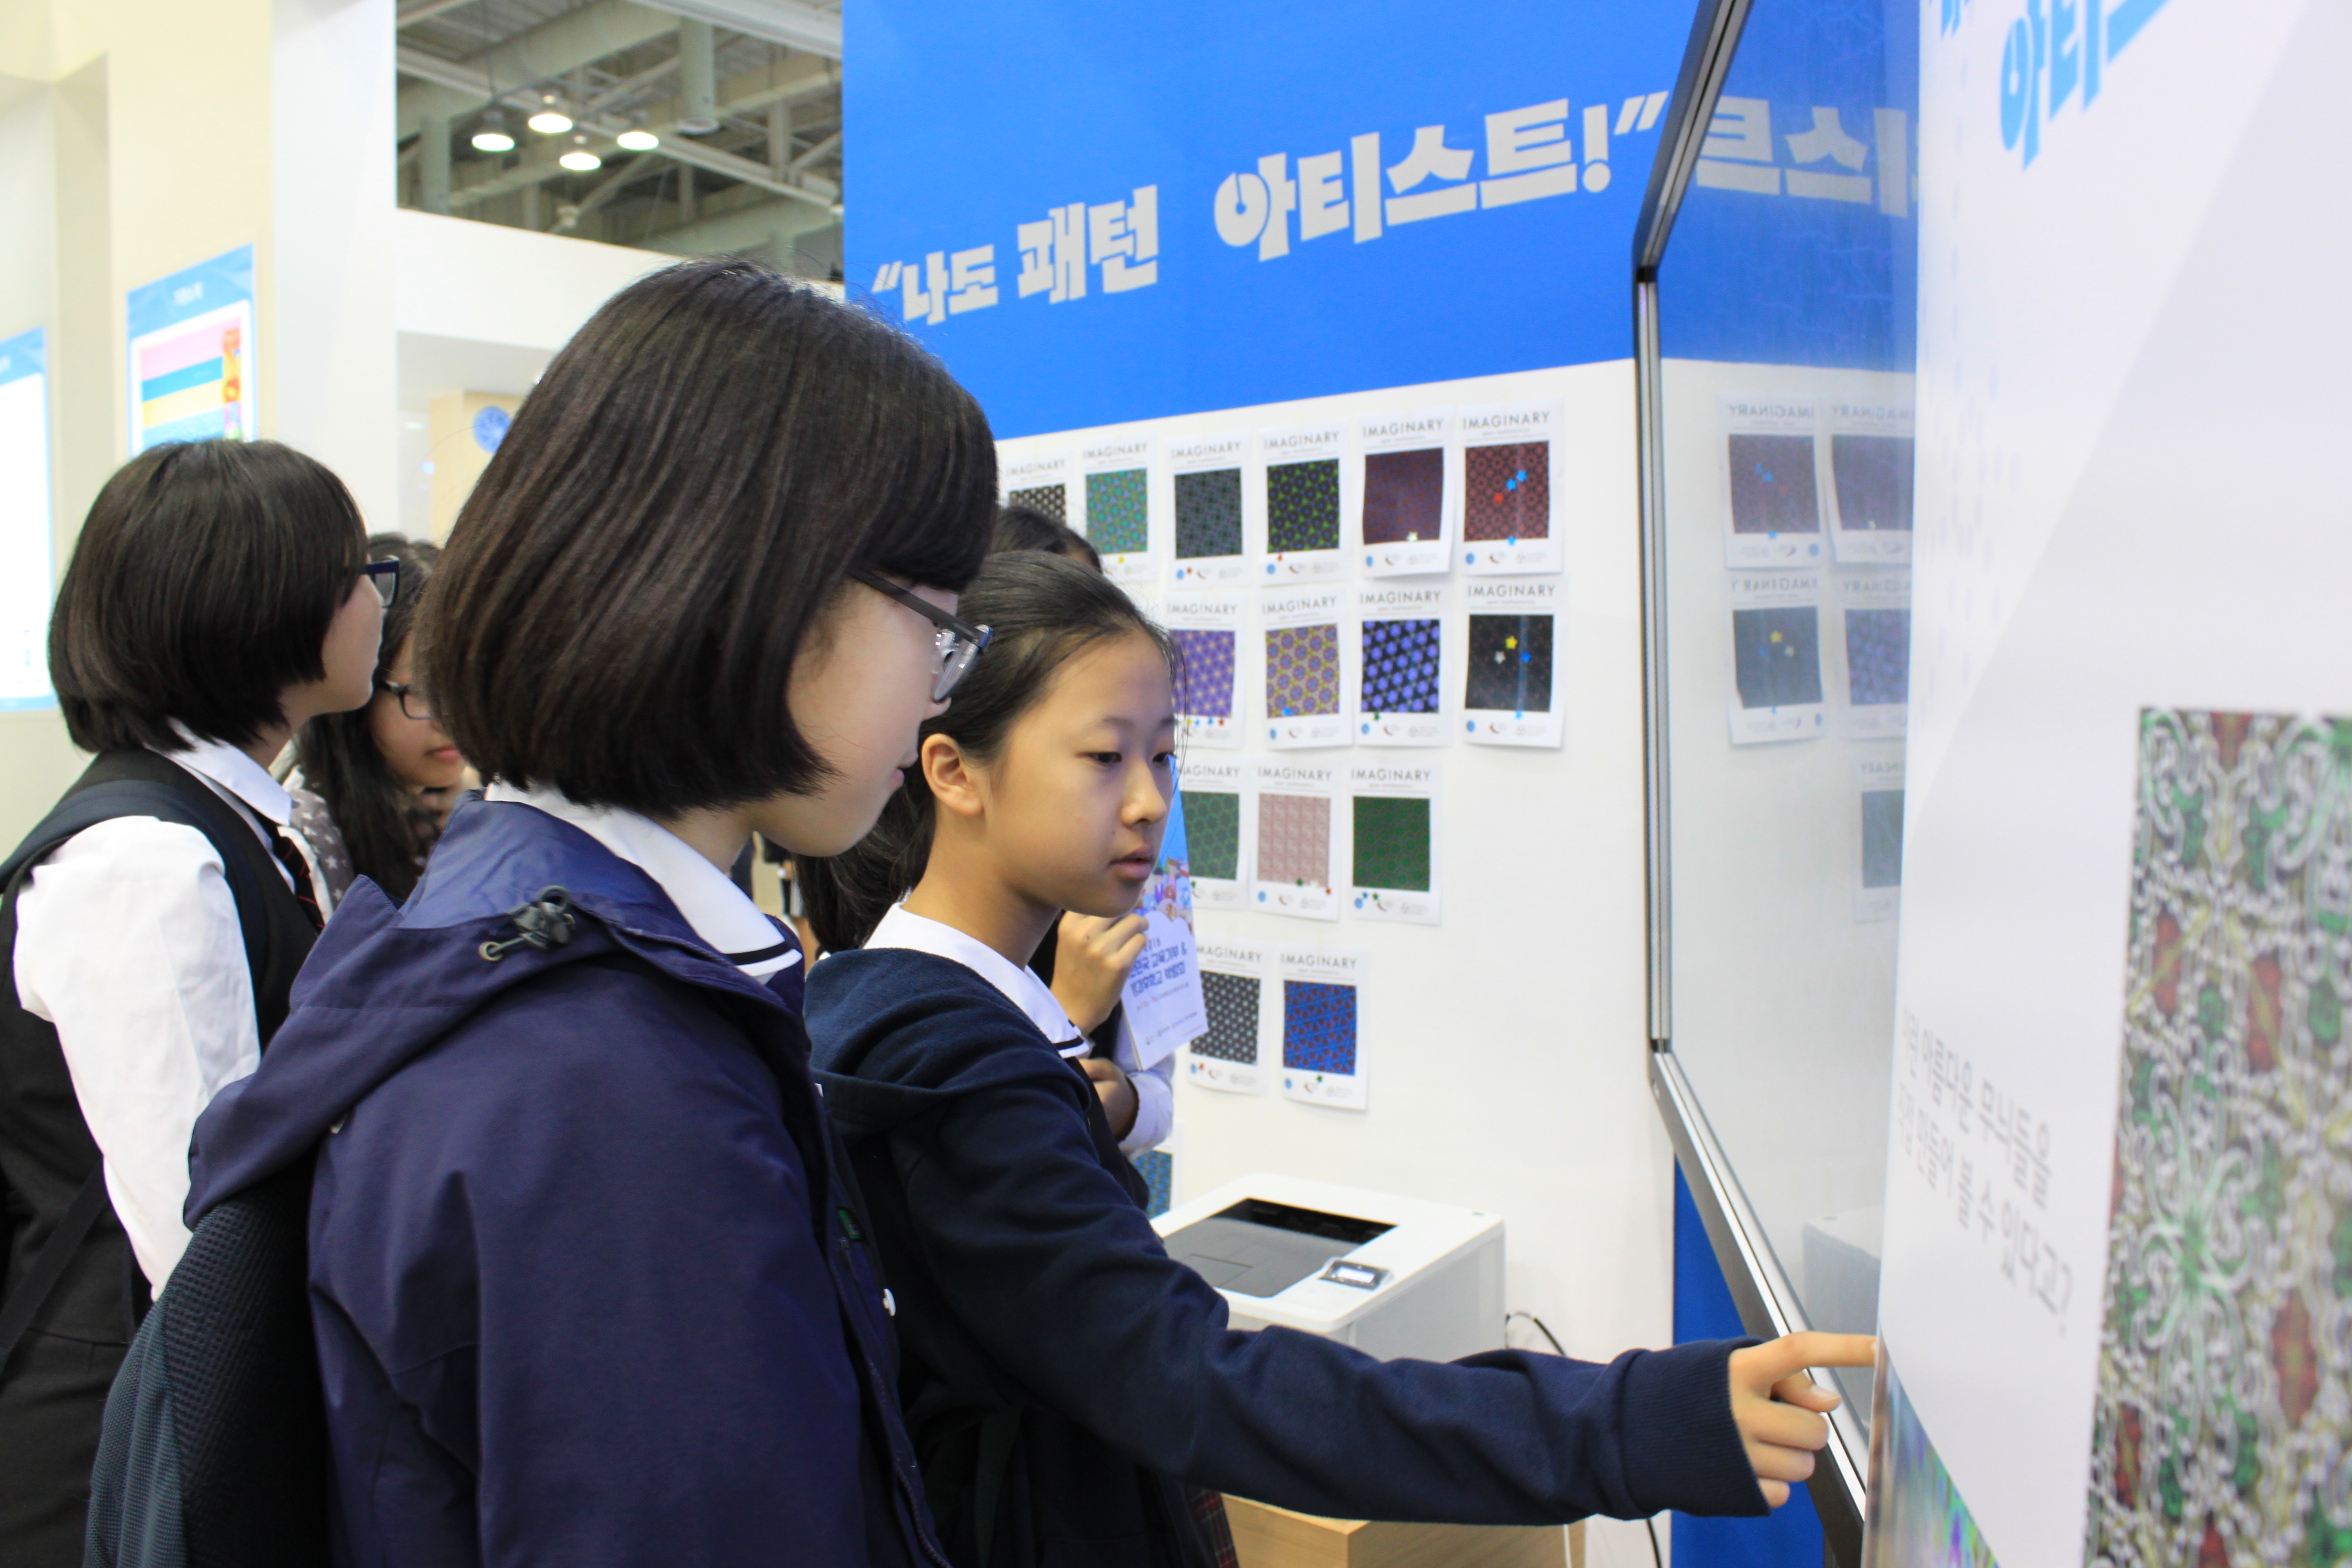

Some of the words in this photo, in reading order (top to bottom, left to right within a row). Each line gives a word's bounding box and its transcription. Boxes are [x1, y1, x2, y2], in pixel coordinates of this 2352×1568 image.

[1017, 184, 1158, 304] 패턴
[1363, 418, 1444, 437] IMAGINARY
[1462, 411, 1550, 430] IMAGINARY
[1264, 430, 1340, 449] IMAGINARY
[1083, 442, 1147, 458] IMAGINARY
[1171, 441, 1241, 459] IMAGINARY
[1007, 459, 1066, 475] IMAGINARY
[1360, 590, 1441, 605] IMAGINARY
[1467, 584, 1556, 598] IMAGINARY
[1167, 602, 1237, 615] IMAGINARY
[1262, 596, 1337, 615] IMAGINARY
[1258, 767, 1332, 781] IMAGINARY
[1351, 768, 1431, 781] IMAGINARY
[1281, 953, 1357, 969] IMAGINARY
